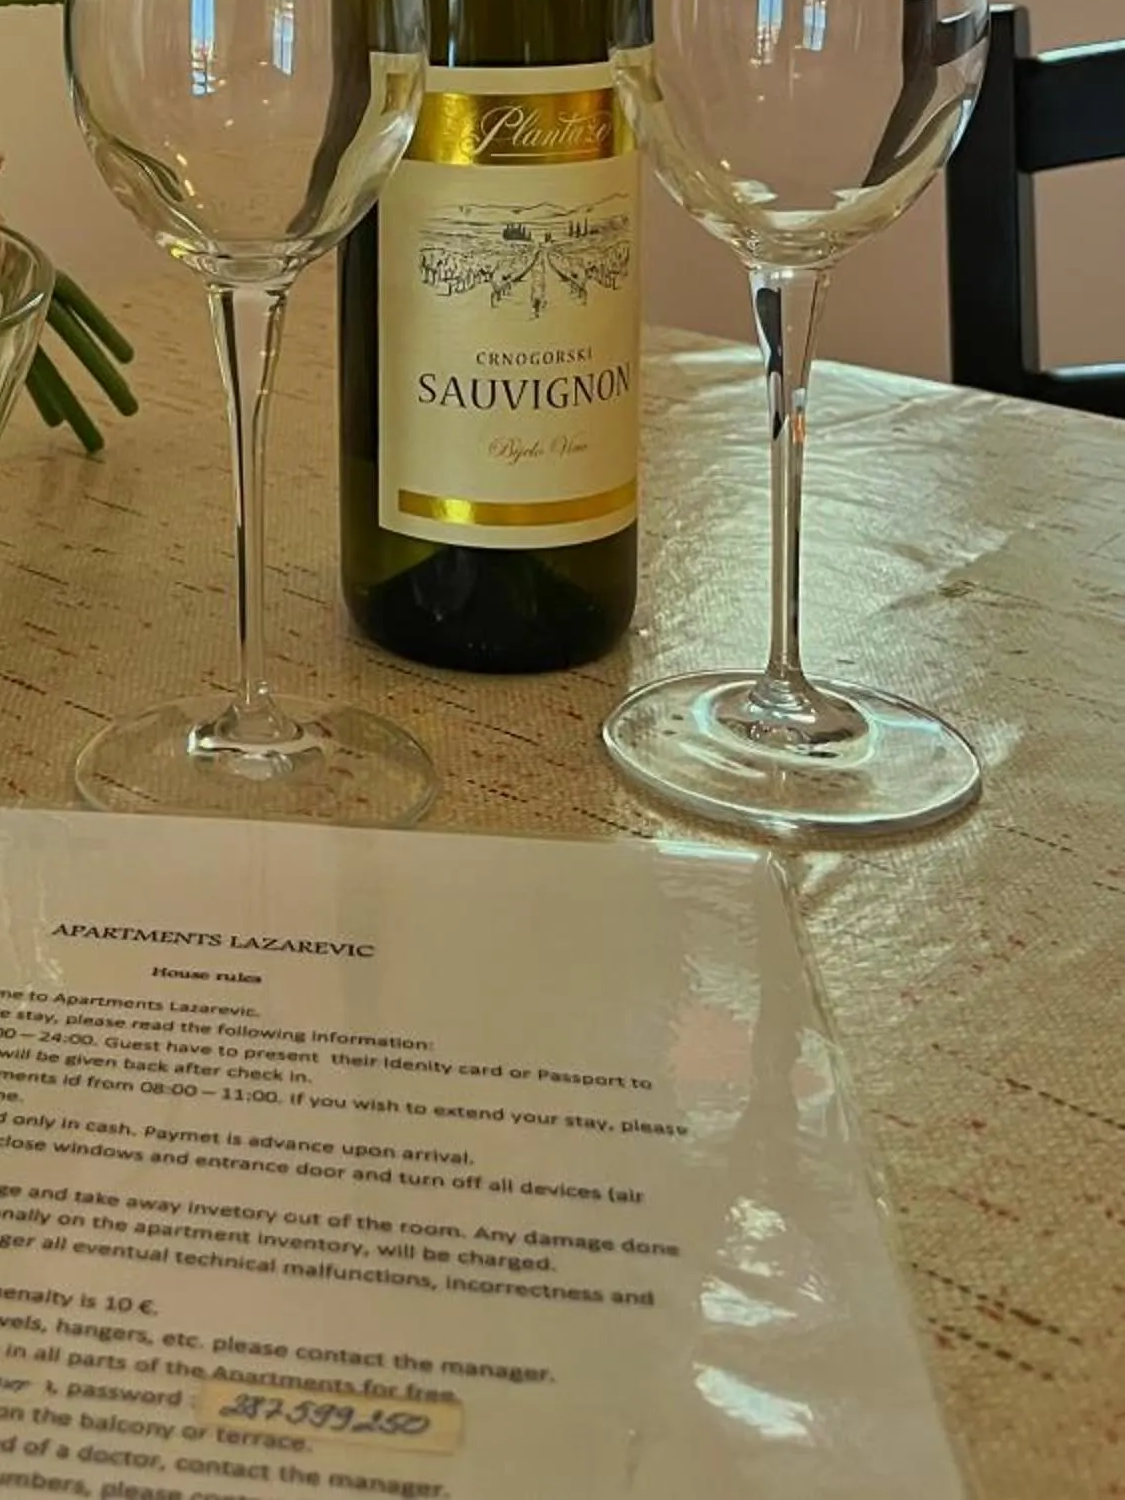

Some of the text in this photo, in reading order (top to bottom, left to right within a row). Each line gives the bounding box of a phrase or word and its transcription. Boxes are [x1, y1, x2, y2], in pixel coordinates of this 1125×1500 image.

[476, 347, 593, 366] CRNOGORSKI
[418, 362, 630, 410] SAUVIGNON
[53, 923, 374, 957] APARTMENTS LAZAREVIC
[152, 966, 262, 984] House rules
[53, 992, 164, 1012] Apartments
[65, 1013, 125, 1030] please
[132, 1017, 174, 1032] read
[218, 1024, 306, 1043] following
[64, 1053, 116, 1070] given
[124, 1055, 167, 1073] back
[175, 1061, 220, 1076] after
[227, 1066, 283, 1082] check
[104, 1037, 160, 1052] Guest
[245, 1049, 318, 1064] present
[459, 1063, 503, 1077] card
[538, 1068, 625, 1088] Passport
[353, 1098, 399, 1113] wish
[434, 1105, 504, 1122] extend
[621, 1120, 688, 1137] please
[145, 1125, 220, 1145] Paymet
[249, 1136, 334, 1153] advance
[342, 1143, 396, 1158] upon
[53, 1140, 144, 1162] windows
[195, 1155, 289, 1174] entrance
[296, 1163, 345, 1179] door
[399, 1173, 444, 1187] turn
[520, 1182, 601, 1200] devices
[75, 1190, 120, 1207] take
[126, 1196, 181, 1213] away
[188, 1202, 276, 1223] invetory
[524, 1231, 615, 1252] damage
[621, 1238, 681, 1257] done
[134, 1222, 250, 1244] apartment
[73, 1241, 169, 1263] eventual
[176, 1252, 275, 1273] technical
[447, 1275, 604, 1303] incorrectness
[106, 1297, 133, 1312] 10
[213, 1336, 288, 1358] please
[296, 1340, 384, 1368] contact
[67, 1352, 126, 1371] parts
[213, 1365, 356, 1394] Apartments
[364, 1378, 399, 1396] for
[66, 1381, 183, 1406] password
[80, 1412, 174, 1440] balcony
